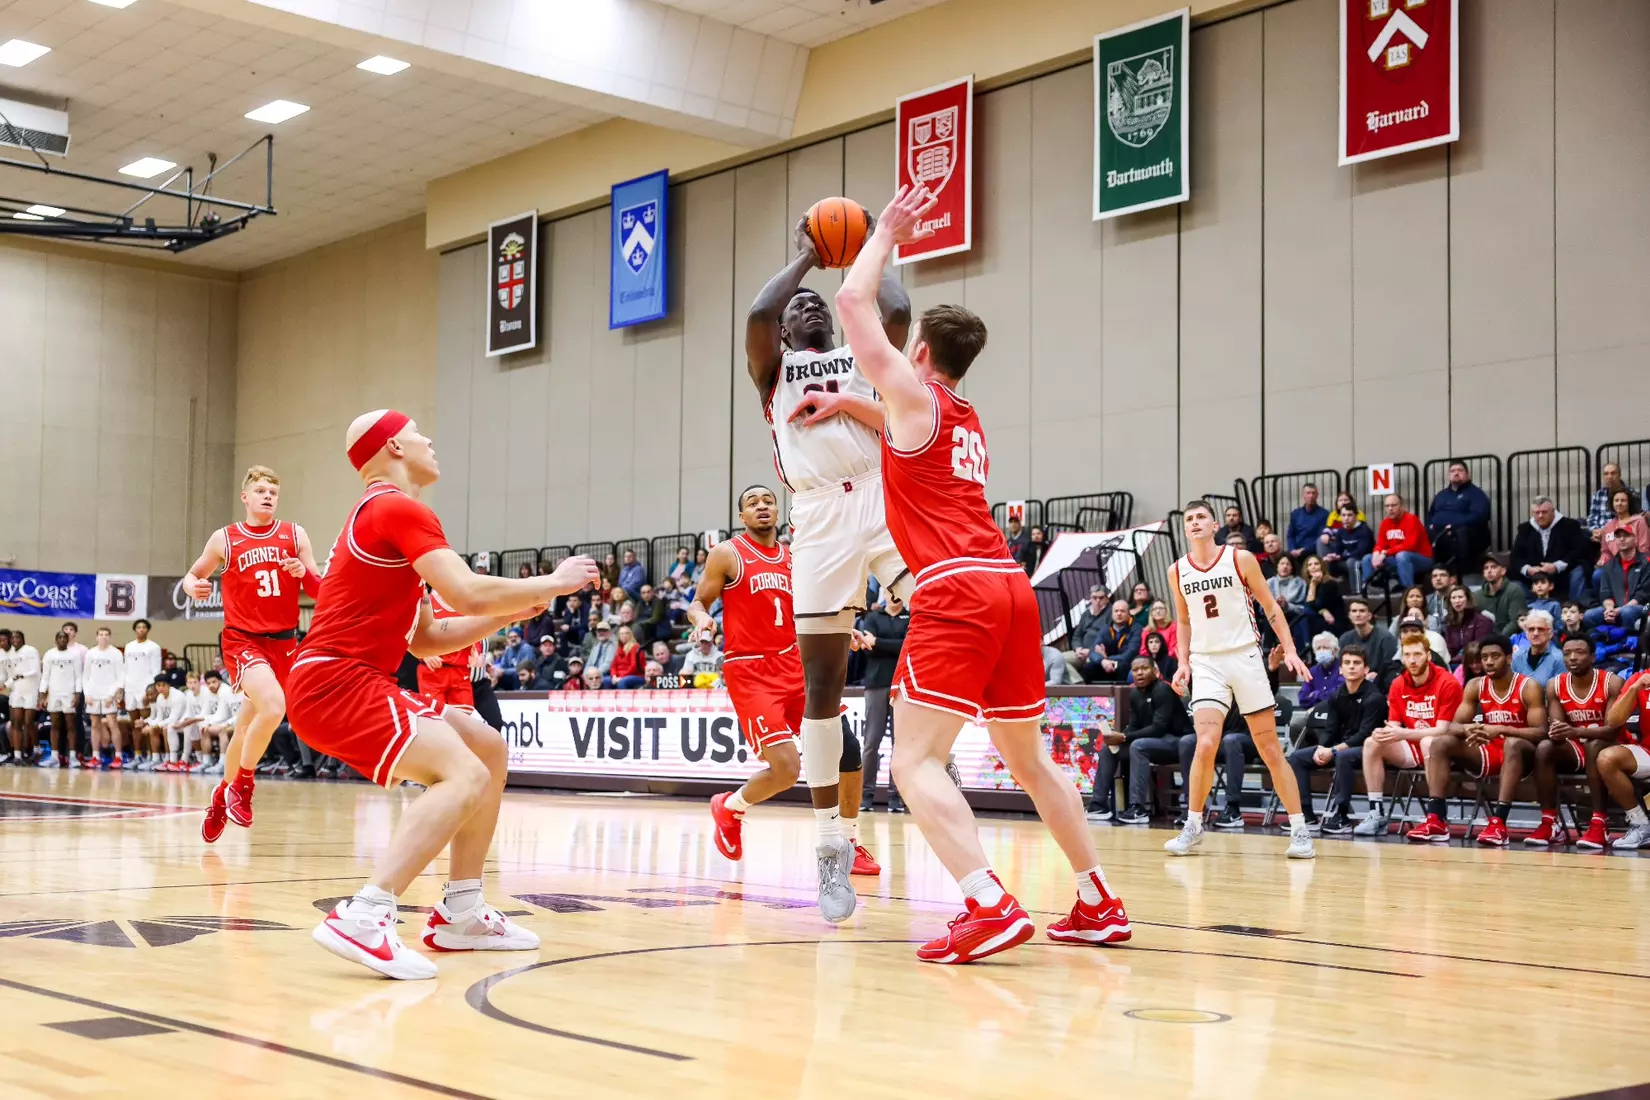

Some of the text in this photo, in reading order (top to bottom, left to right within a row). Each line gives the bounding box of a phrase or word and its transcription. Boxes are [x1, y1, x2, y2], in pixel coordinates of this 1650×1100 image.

[1366, 100, 1429, 133] Harvard
[1127, 128, 1154, 143] 1769
[1107, 157, 1173, 188] Dartmouth
[786, 357, 854, 383] BROWN
[951, 425, 986, 486] 20
[843, 482, 853, 493] B
[1373, 469, 1390, 490] N
[708, 534, 716, 549] L
[238, 546, 284, 572] CORNEL
[255, 569, 281, 598] 31
[750, 573, 793, 595] CORNEL
[1184, 576, 1233, 595] BROWN
[105, 580, 136, 616] B
[1203, 594, 1219, 619] 2
[774, 597, 783, 626] 1
[756, 715, 768, 733] C
[569, 716, 748, 764] VISIT US!
